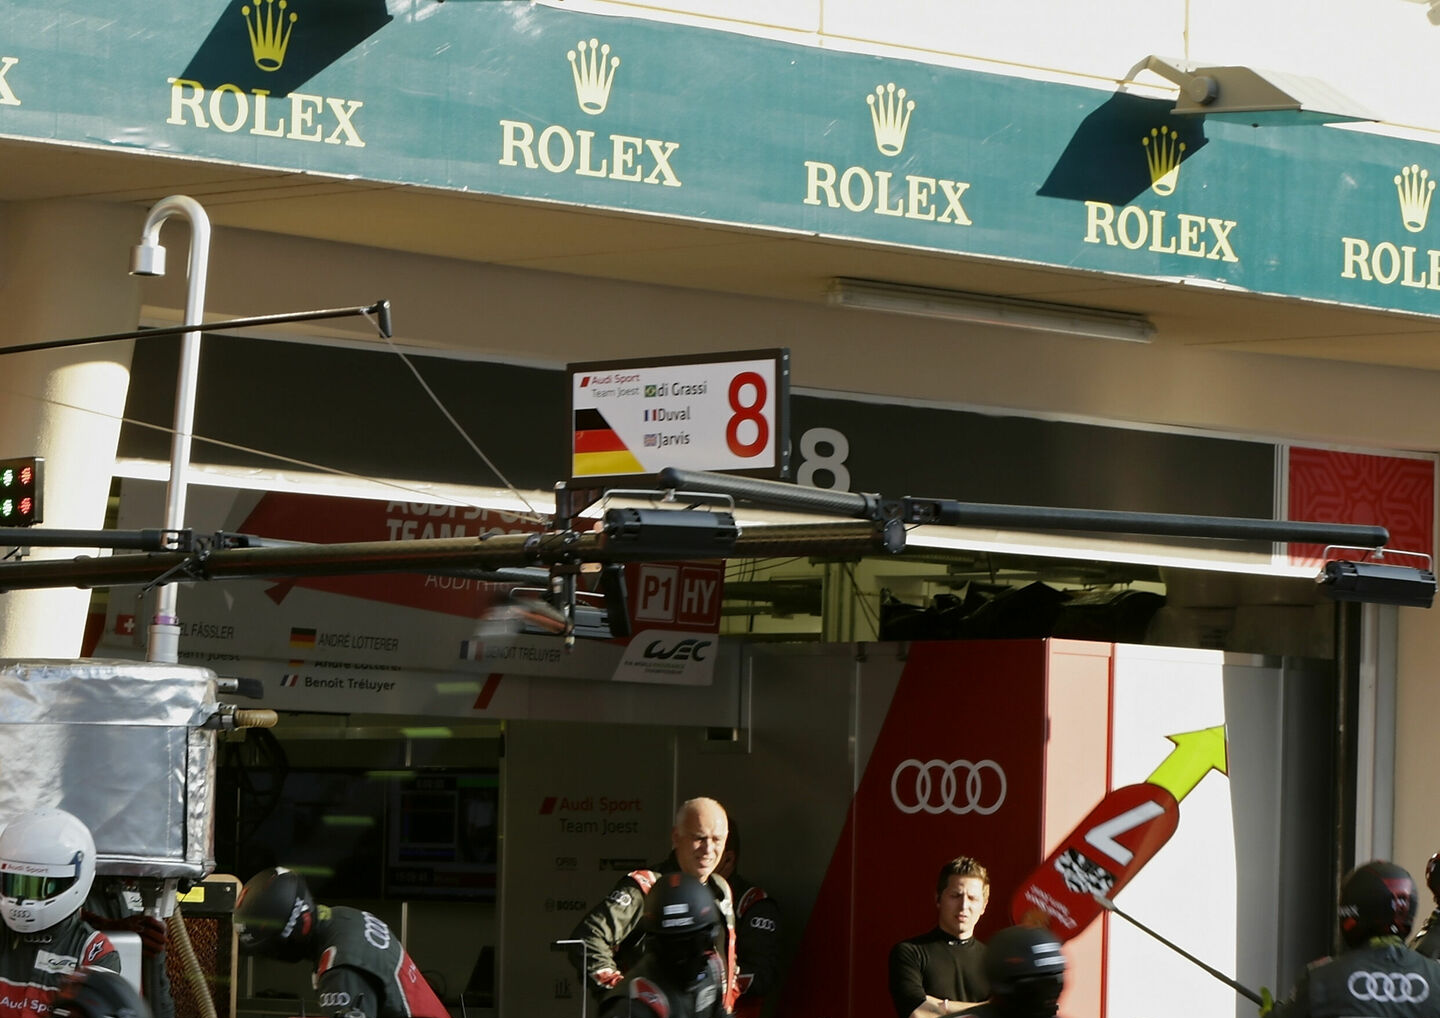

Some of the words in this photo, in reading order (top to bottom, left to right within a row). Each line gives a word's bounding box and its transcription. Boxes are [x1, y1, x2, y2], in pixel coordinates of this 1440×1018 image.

[166, 77, 366, 147] ROLEX
[499, 119, 681, 187] ROLEX
[803, 161, 972, 226] ROLEX
[1084, 200, 1238, 262] ROLEX
[591, 375, 612, 385] Audi
[614, 374, 640, 384] Sport
[657, 384, 668, 397] di
[671, 381, 707, 396] Grassi
[592, 388, 615, 398] Team
[617, 387, 640, 397] Joest
[658, 406, 690, 421] Duval
[726, 372, 769, 458] 8
[658, 431, 690, 448] Jarvis
[790, 427, 851, 492] 8
[642, 575, 672, 611] P1
[681, 578, 717, 615] HY
[318, 632, 350, 648] ANDRÉ
[351, 635, 399, 653] LOTTERER
[644, 639, 711, 661] WEC
[348, 678, 396, 692] Tréluyer
[560, 797, 593, 811] Audi
[599, 797, 642, 813] Sport
[560, 818, 598, 834] Team
[602, 819, 639, 836] Joest
[24, 866, 49, 874] Sport
[0, 996, 28, 1010] Audi
